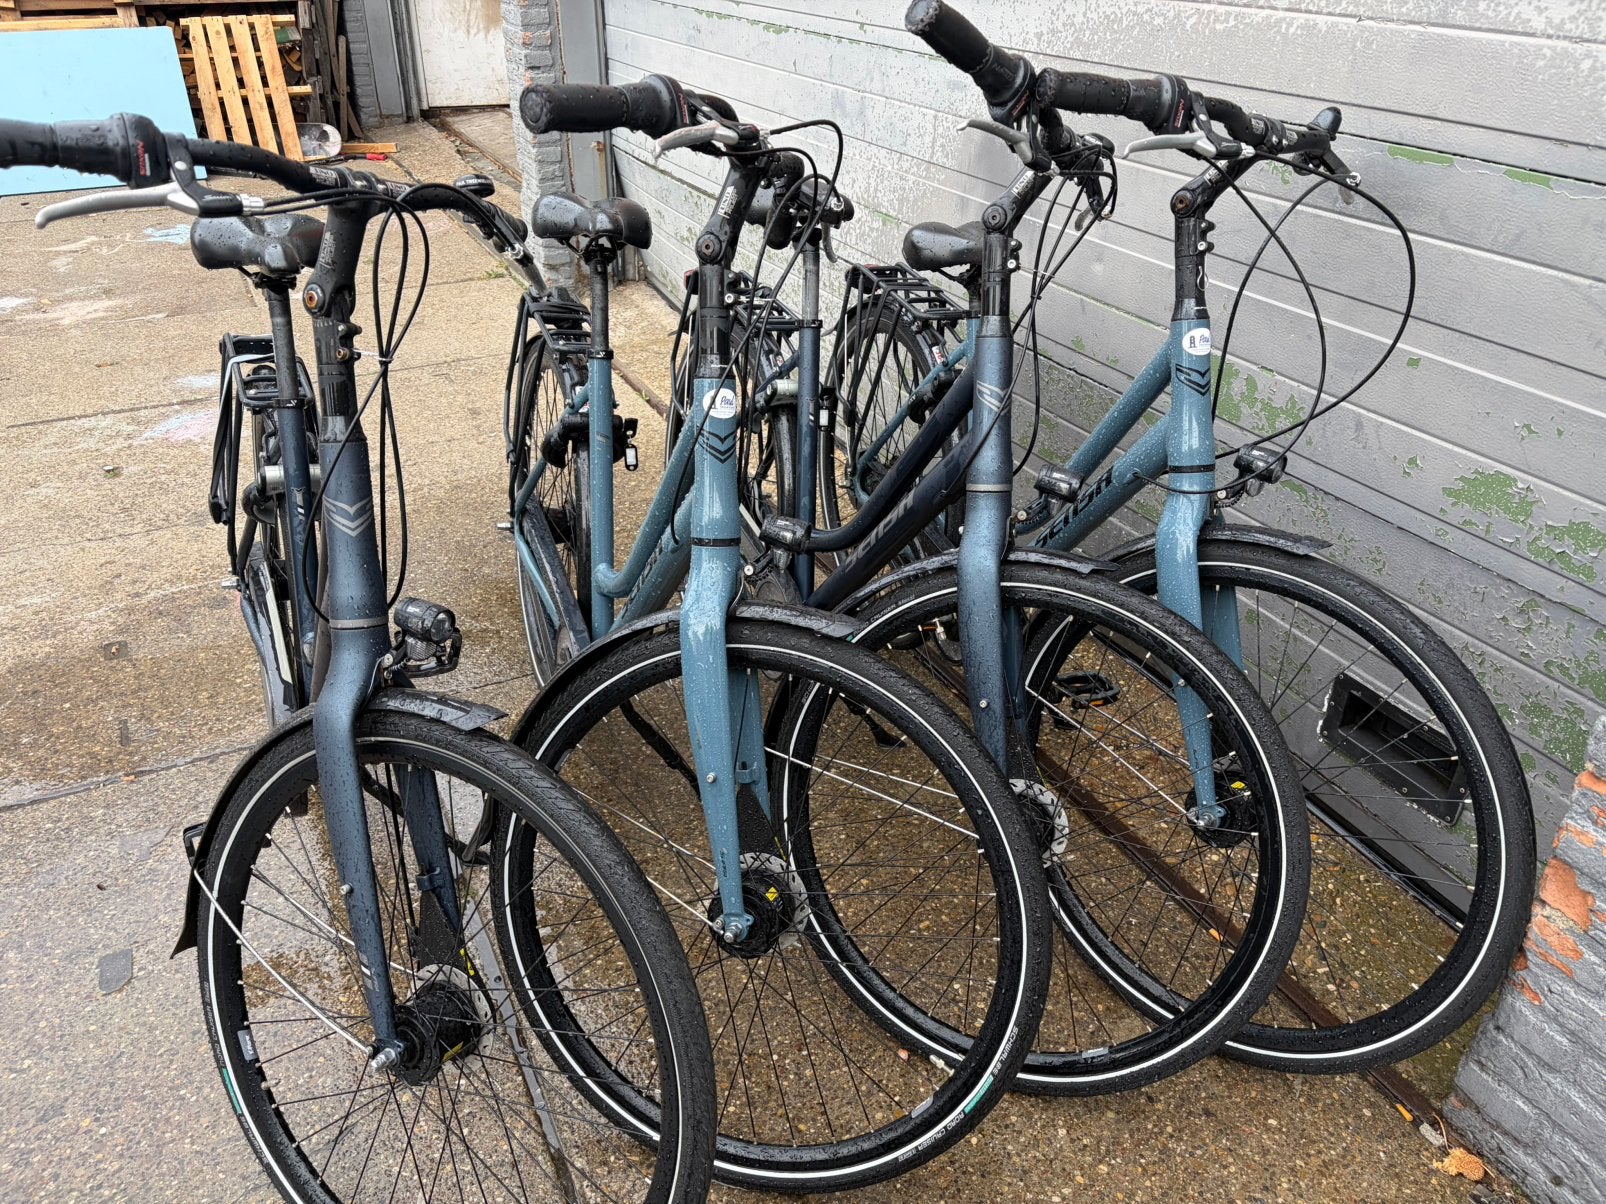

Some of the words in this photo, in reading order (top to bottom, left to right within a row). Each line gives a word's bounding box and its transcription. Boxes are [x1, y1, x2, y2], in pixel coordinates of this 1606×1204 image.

[204, 1005, 219, 1041] CRUISER
[991, 1024, 1019, 1076] SCHWALBE
[945, 1111, 965, 1130] ROAD
[915, 1128, 947, 1150] CRUISER
